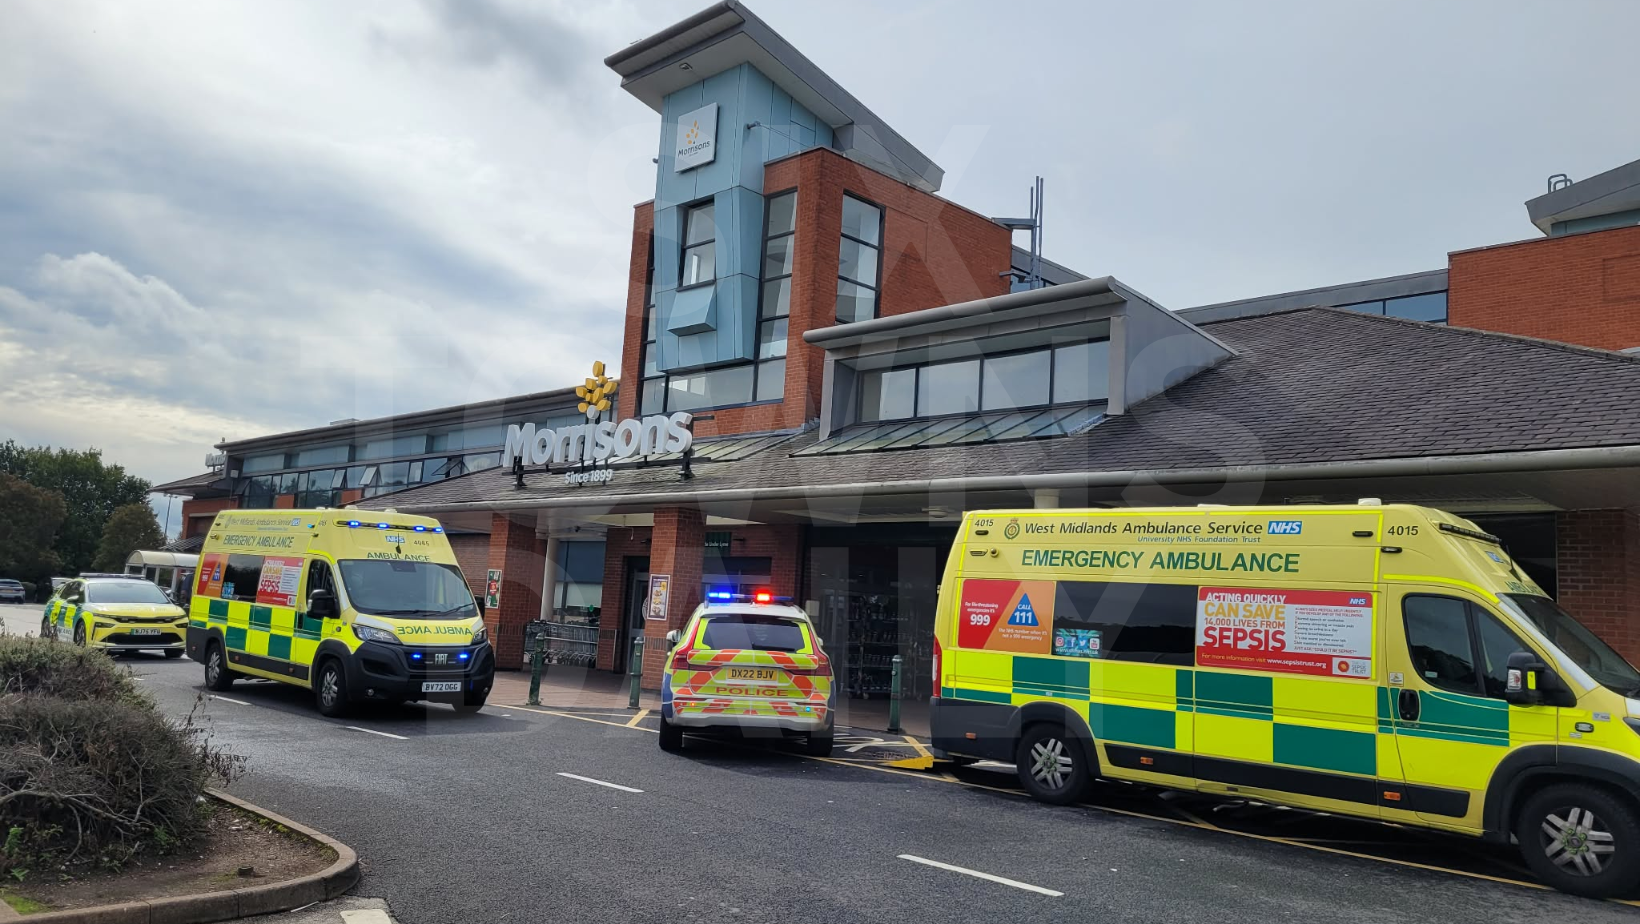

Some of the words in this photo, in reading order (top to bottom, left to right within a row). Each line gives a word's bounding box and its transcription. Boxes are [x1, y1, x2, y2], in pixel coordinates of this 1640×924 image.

[677, 140, 710, 157] Morrisons
[502, 405, 693, 467] Morrisons
[564, 472, 589, 484] Since
[590, 469, 613, 482] 1899
[974, 519, 994, 527] 4015
[1025, 523, 1055, 534] West
[1059, 522, 1117, 534] Midlands
[1122, 522, 1201, 534] Ambulance
[1207, 521, 1263, 534] Service
[1268, 521, 1302, 534] NHS
[1388, 526, 1419, 536] 4015
[256, 536, 295, 548] AMBULANCE
[386, 535, 405, 543] NHS
[1137, 536, 1175, 544] University
[367, 552, 431, 562] AMBULANCE
[1022, 550, 1144, 569] EMERGENCY
[1149, 551, 1300, 573] AMBULANCE
[1205, 592, 1242, 603] ACTING
[1243, 594, 1287, 605] QUICKLY
[1204, 602, 1240, 618] CAN
[1242, 603, 1286, 620] SAVE
[970, 614, 991, 626] 999
[1014, 612, 1033, 624] 111
[1232, 619, 1258, 628] LIVES
[1260, 621, 1286, 629] FROM
[1203, 626, 1287, 651] SEPSIS
[434, 654, 448, 665] FIAT
[1267, 658, 1327, 669] www.sepsistrust.org
[731, 669, 755, 678] DX22
[756, 670, 774, 679] BJV
[716, 687, 789, 697] POLICE
